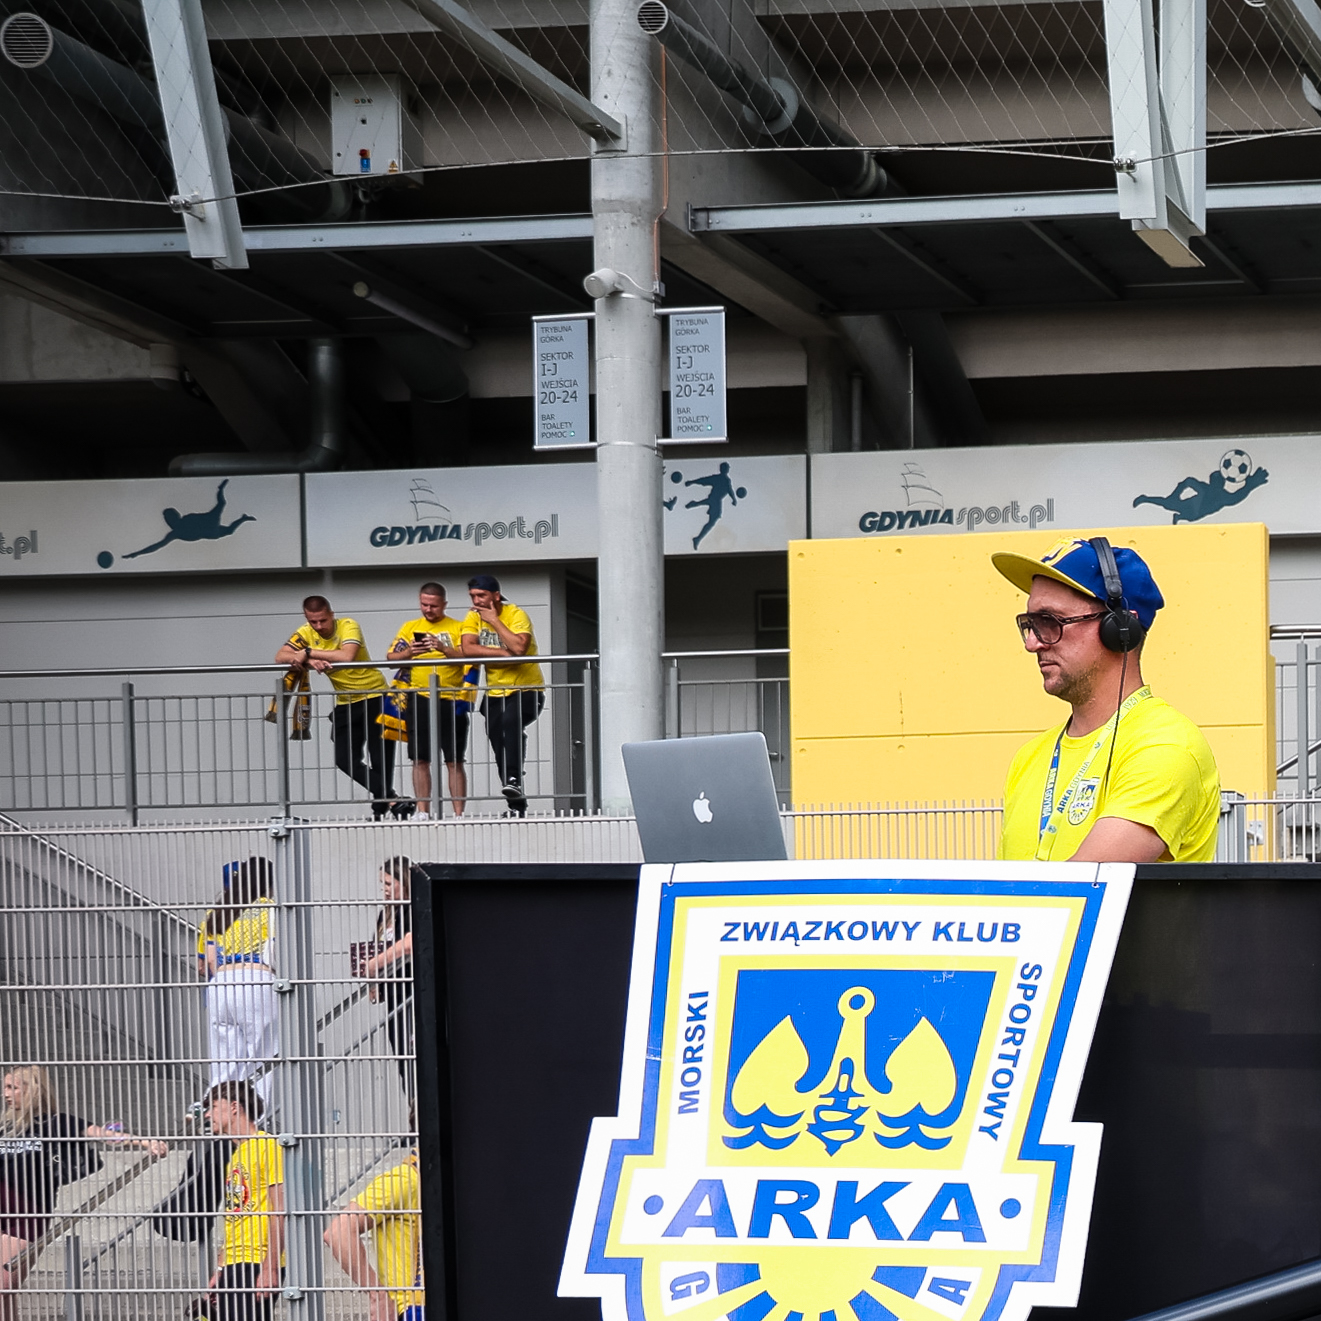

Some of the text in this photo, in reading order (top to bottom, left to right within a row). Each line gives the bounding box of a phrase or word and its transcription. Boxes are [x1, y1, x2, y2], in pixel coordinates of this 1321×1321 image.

[675, 318, 709, 326] TRYBUNA
[540, 326, 573, 334] TRYBUNA
[675, 326, 700, 336] GÓRKA
[540, 334, 564, 344] GÓRKA
[675, 344, 710, 354] SEKTOR
[540, 352, 574, 361] SEKTOR
[676, 370, 715, 382] WEJŚCIA
[541, 378, 579, 390] WEJŚCIA
[675, 384, 715, 398] 20-24
[540, 390, 578, 405] 20-24
[676, 407, 691, 415] BAR
[677, 415, 710, 424] TOALETY
[542, 422, 573, 430] TOALETY
[677, 424, 704, 432] POMOC
[541, 430, 567, 438] POMOC
[1056, 761, 1090, 814] ARKA GDYNIA
[720, 920, 1022, 946] ZWIĄZKOWY KLUB
[678, 989, 710, 1116] MORSKI
[977, 961, 1043, 1142] SPORTOWY
[660, 1178, 987, 1243] ARKA
